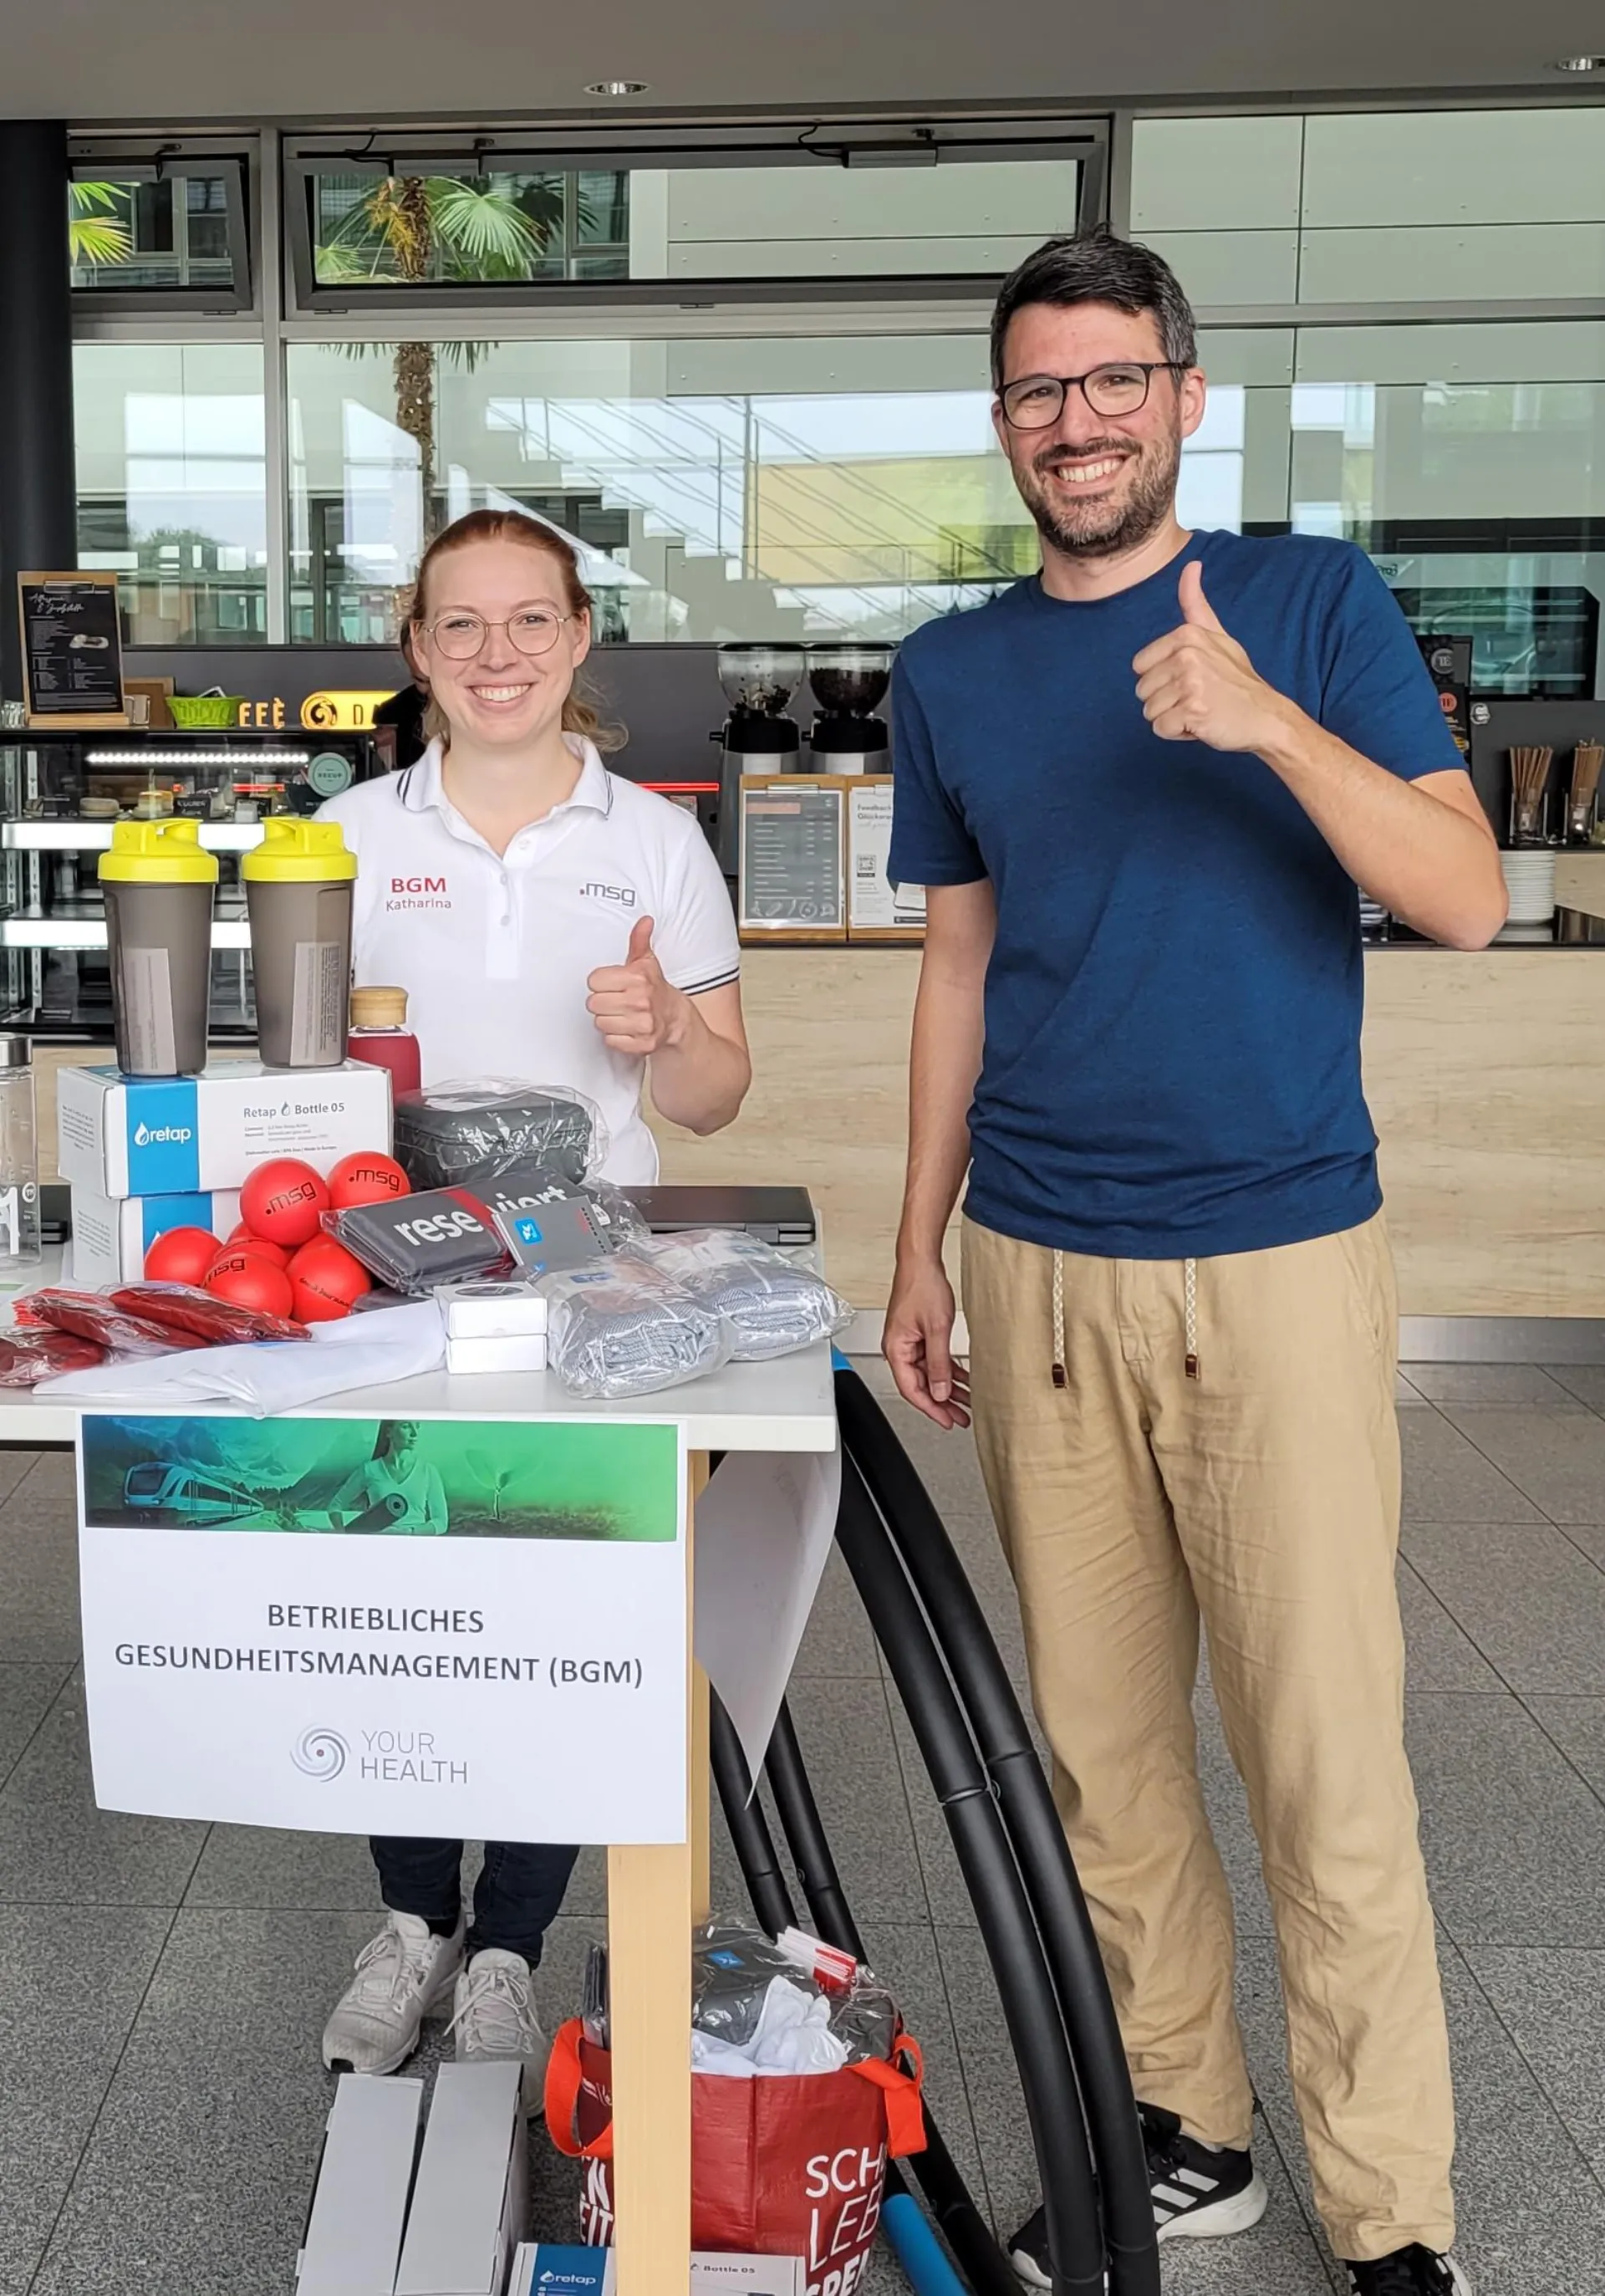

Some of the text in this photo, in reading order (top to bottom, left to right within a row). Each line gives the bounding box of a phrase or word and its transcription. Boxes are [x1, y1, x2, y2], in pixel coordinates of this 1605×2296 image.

[391, 877, 446, 894] BGM
[579, 882, 636, 907] .msg
[385, 896, 452, 912] Katharina
[243, 1102, 345, 1119] Retap Bottle 05
[150, 1125, 191, 1145] retap
[349, 1169, 401, 1192] .msg
[265, 1181, 318, 1216] .msg
[393, 1211, 485, 1246] rese
[268, 1604, 484, 1634] BETRIEBLICHES
[115, 1643, 644, 1690] GESUNDHEITSMANAGEMENT (BGM)
[361, 1728, 435, 1755] YOUR
[360, 1757, 468, 1784] HEALTH
[703, 2264, 739, 2273] Bottle
